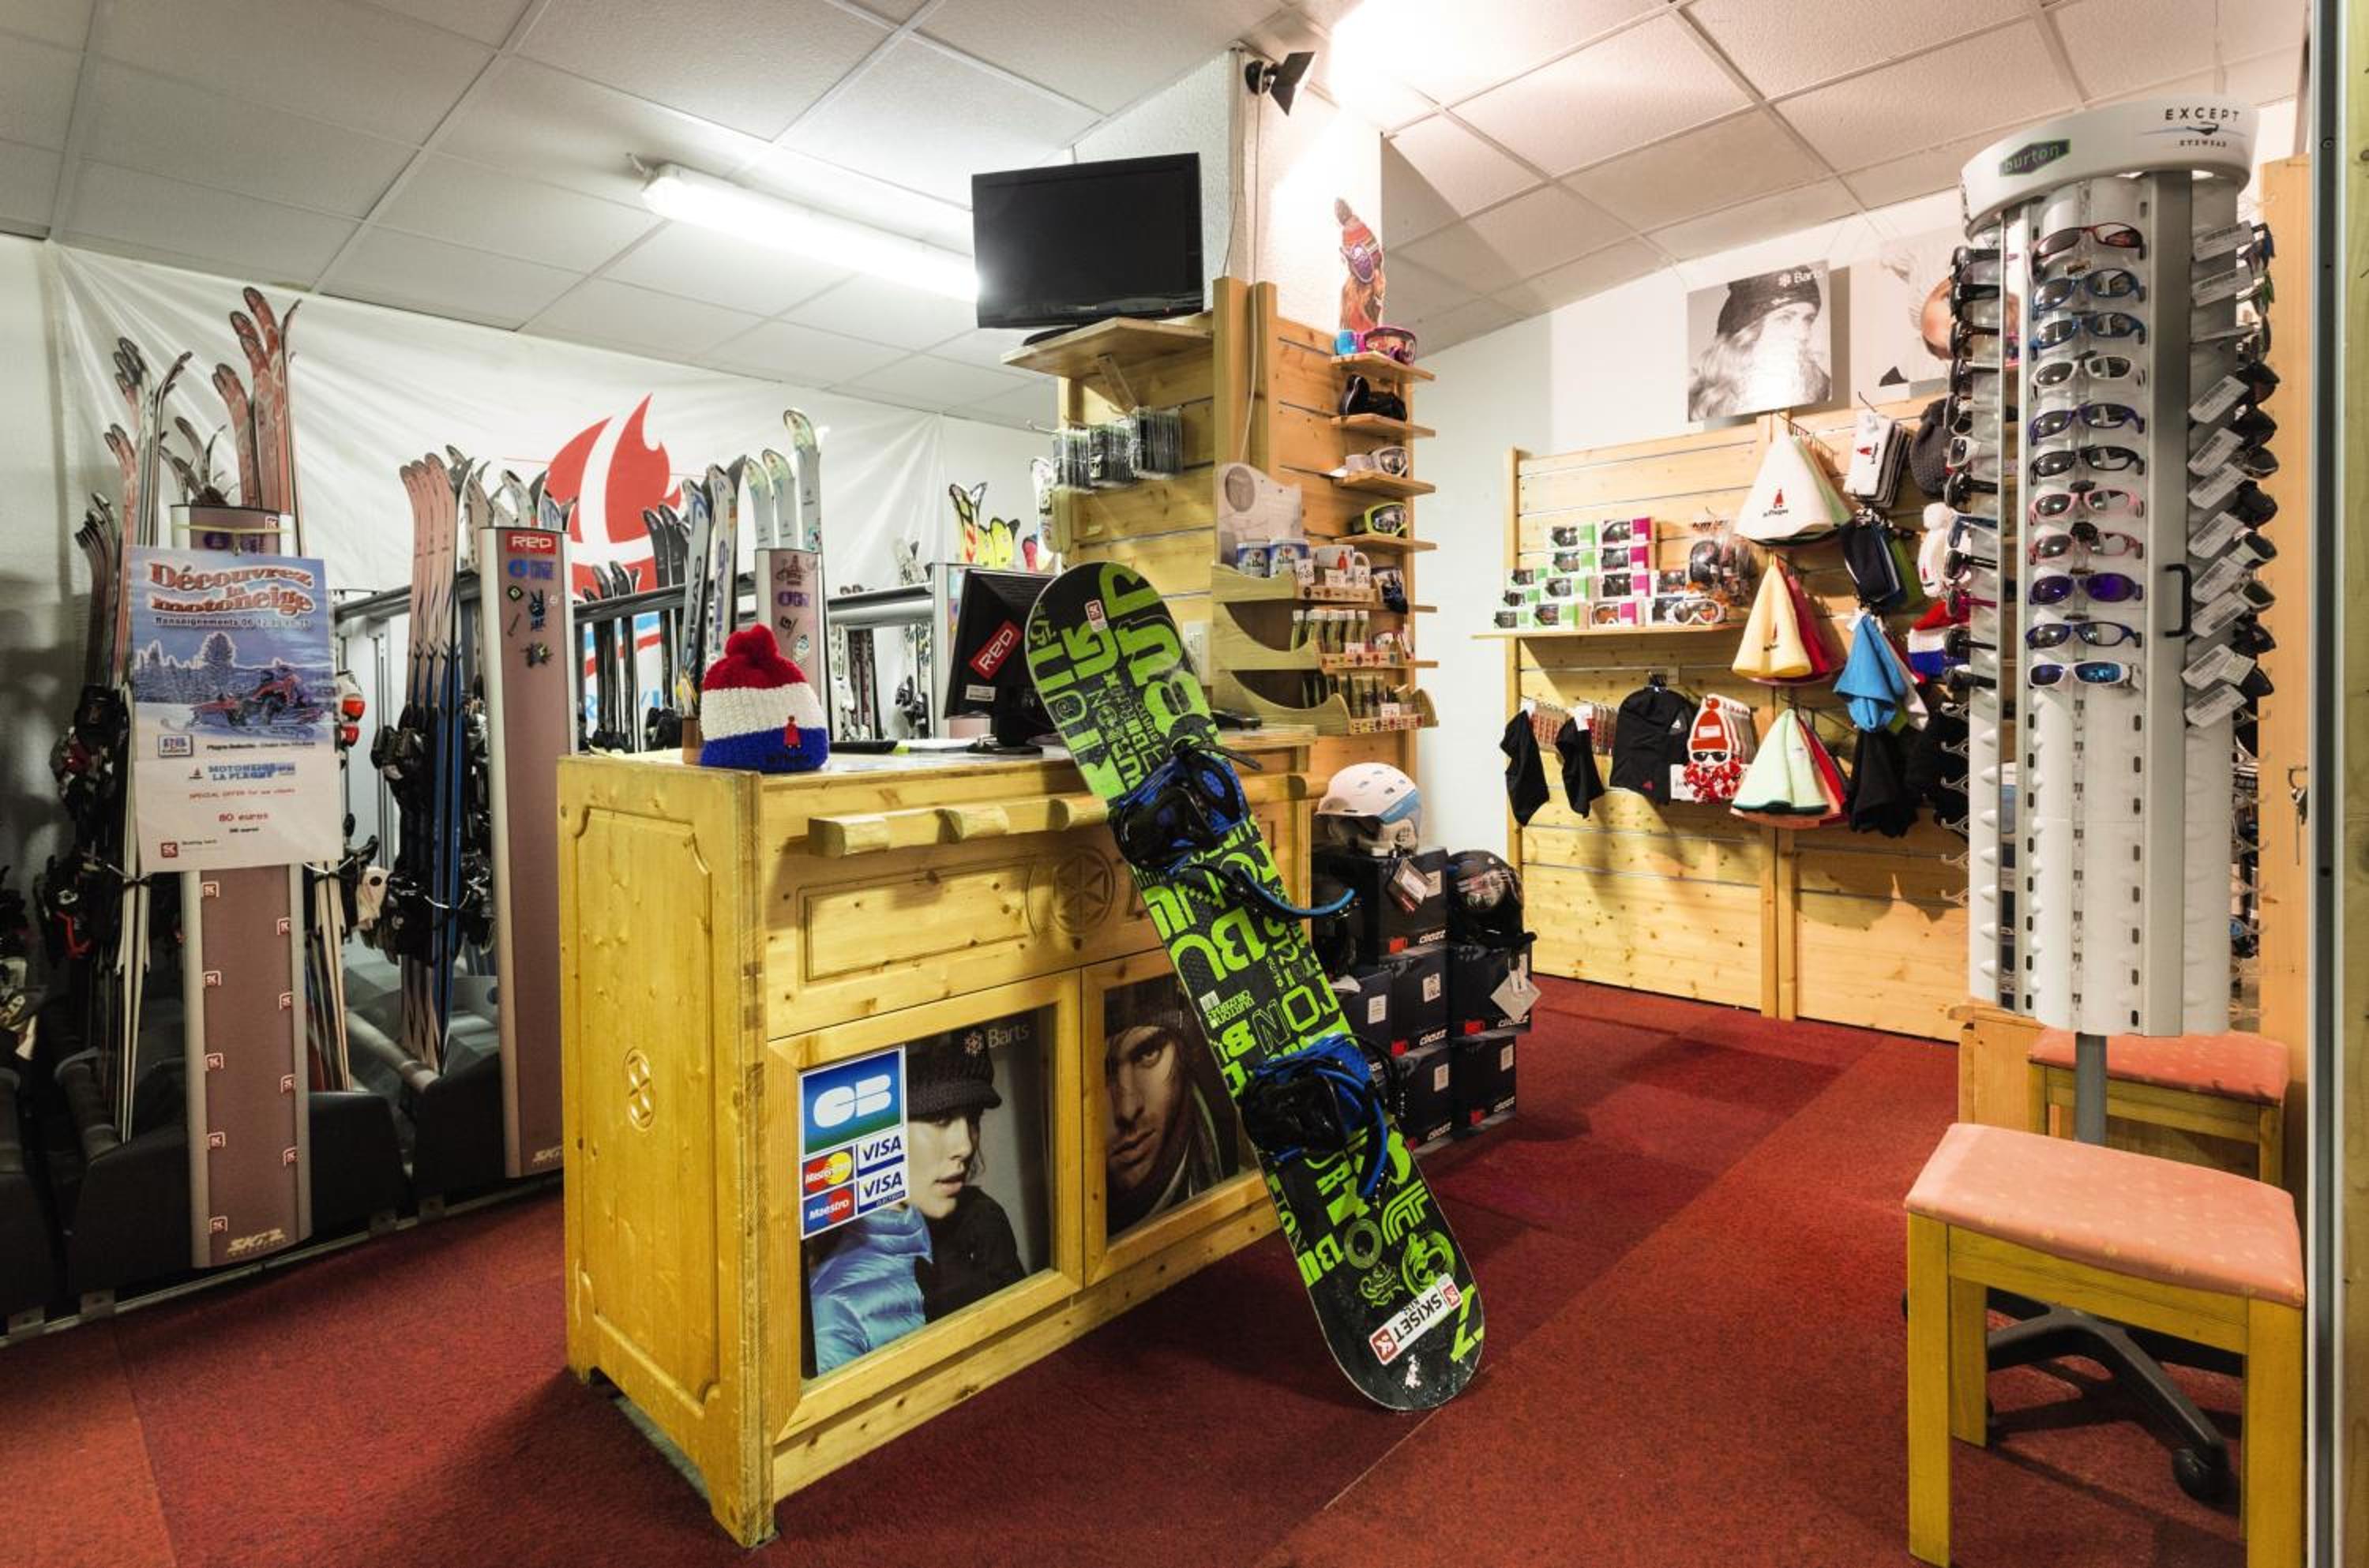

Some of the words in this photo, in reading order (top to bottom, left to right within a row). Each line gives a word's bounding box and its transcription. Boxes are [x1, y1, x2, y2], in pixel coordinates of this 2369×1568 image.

[2164, 107, 2239, 122] EXCEPT
[150, 561, 313, 591] Découvrez
[151, 586, 313, 616] motoneige
[978, 629, 1013, 670] RED
[987, 1025, 1030, 1048] Barts
[812, 1073, 892, 1129] CB
[862, 1135, 902, 1161] VISA
[864, 1171, 903, 1199] VISA
[808, 1199, 850, 1221] Maestro
[1393, 1293, 1444, 1342] SKISET
